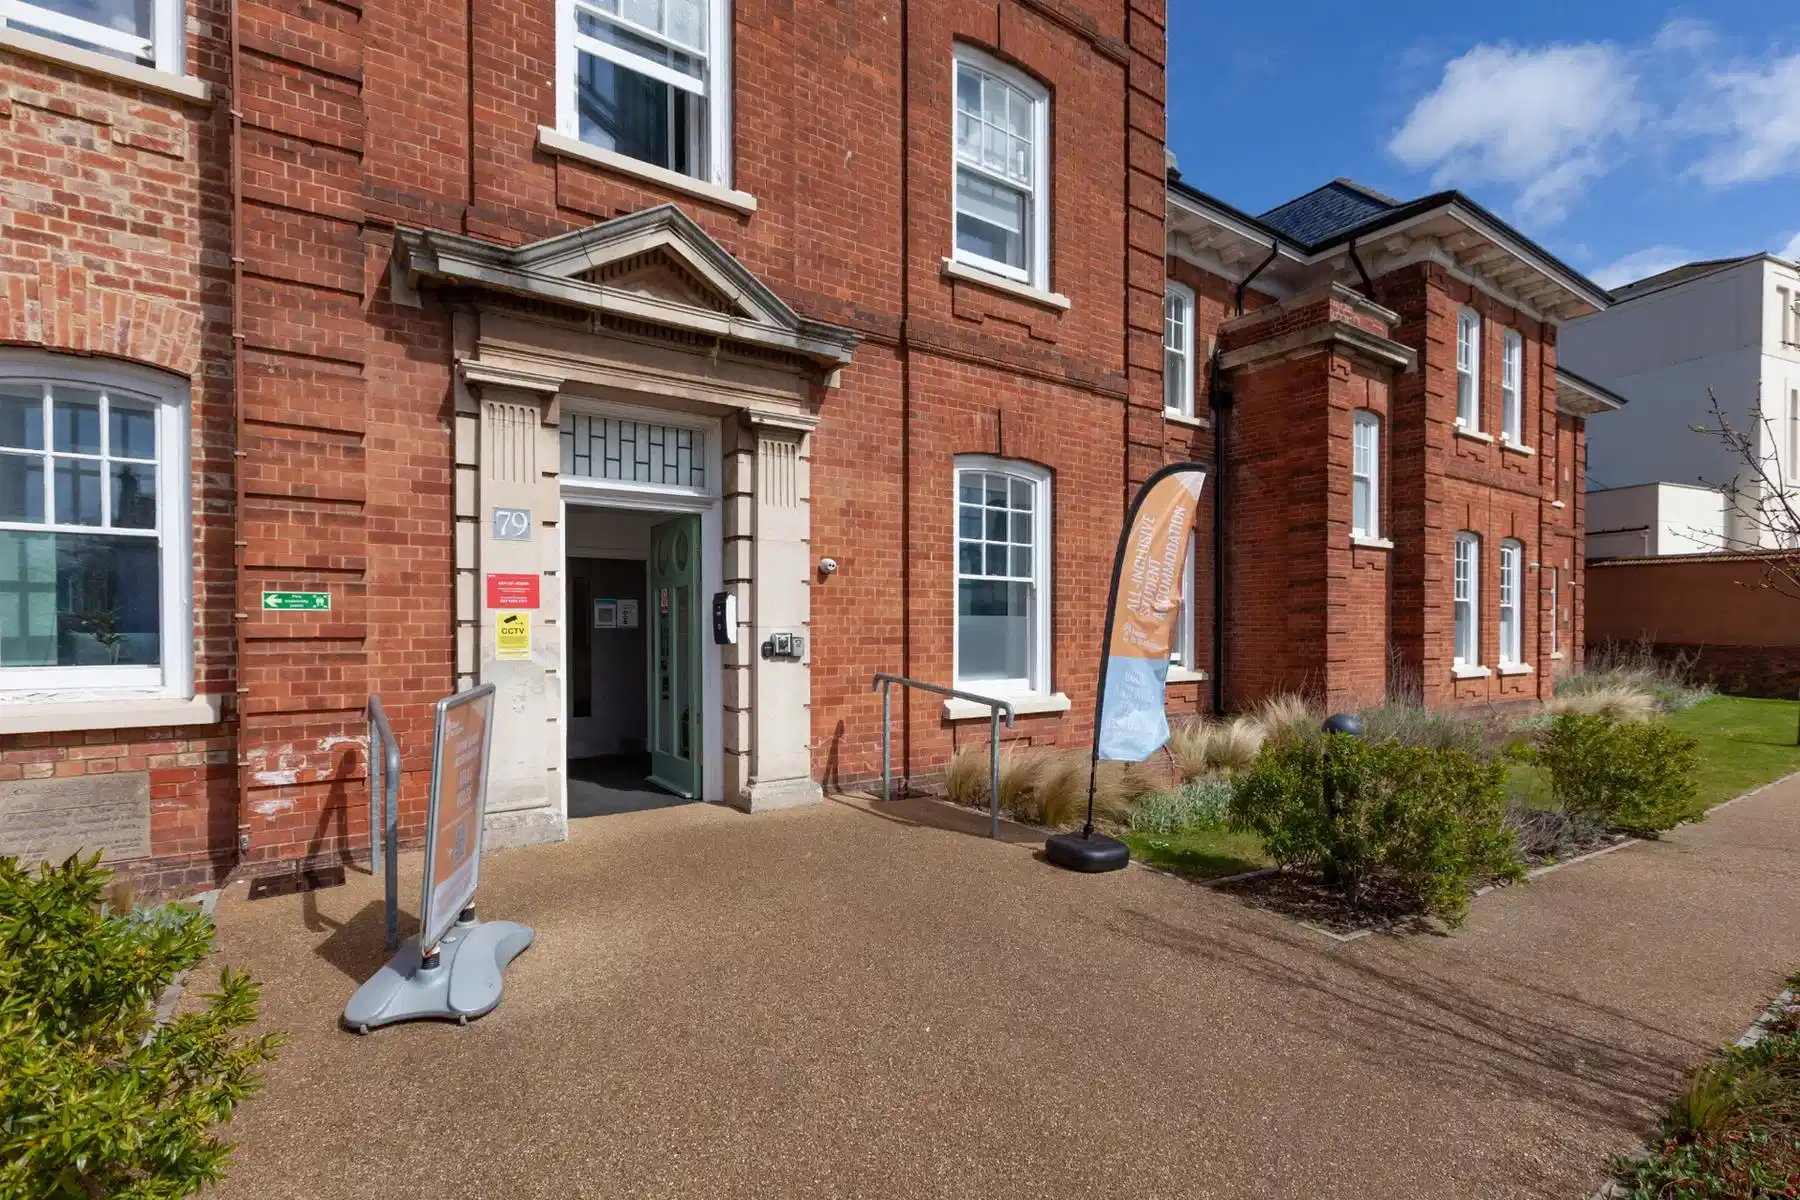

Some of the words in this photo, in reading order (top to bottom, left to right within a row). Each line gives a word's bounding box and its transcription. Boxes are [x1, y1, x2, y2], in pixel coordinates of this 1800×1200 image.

[496, 511, 528, 537] 79
[1126, 515, 1156, 612] ALL-INCLUSIVE
[1140, 555, 1161, 617] STUDENT
[1152, 504, 1186, 621] ACCOMMODATION
[501, 627, 525, 635] CCTV
